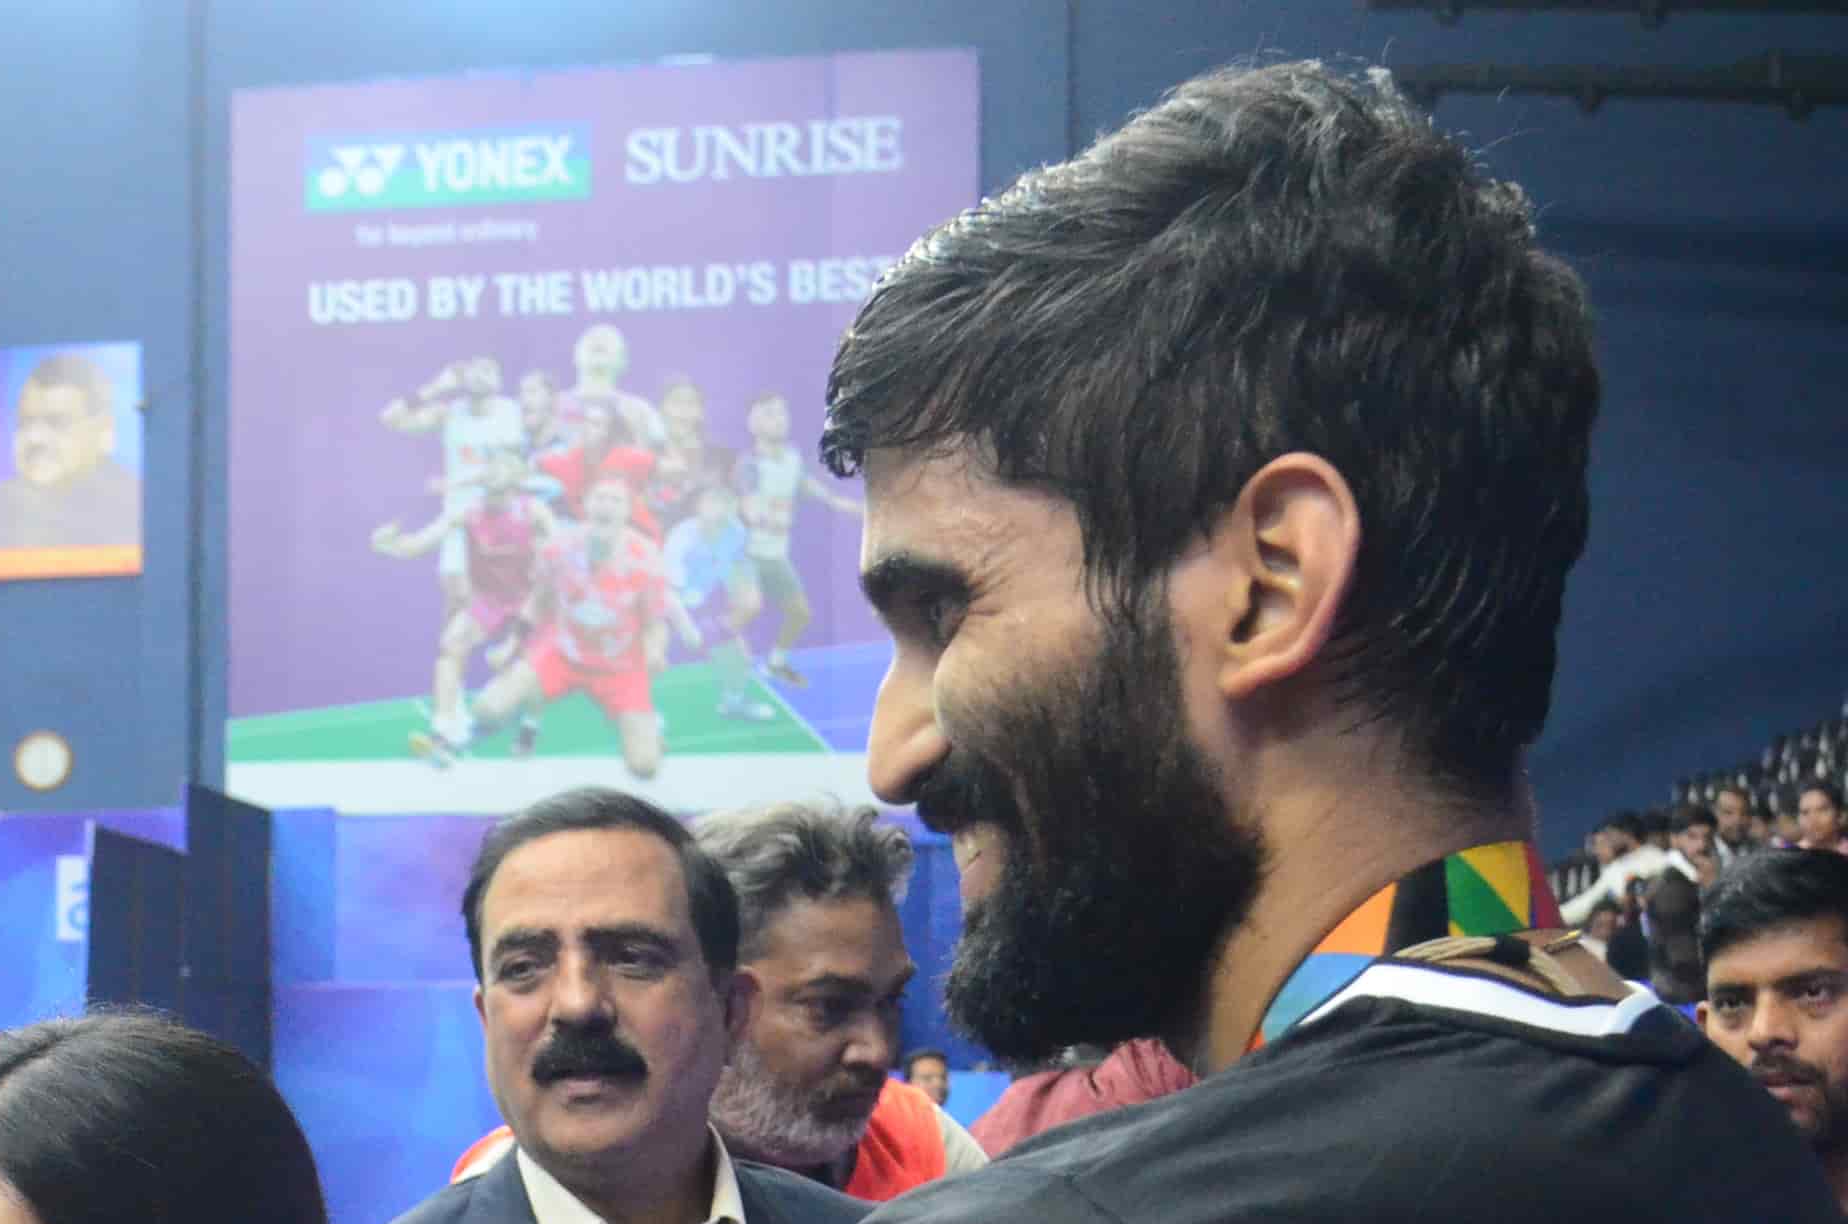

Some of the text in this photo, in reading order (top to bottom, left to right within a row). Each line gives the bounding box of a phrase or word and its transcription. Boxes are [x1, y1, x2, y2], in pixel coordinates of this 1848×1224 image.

[416, 134, 573, 192] YONEX
[624, 116, 902, 184] SUNRISE
[309, 277, 418, 324] USED
[427, 273, 488, 319] BY
[493, 269, 574, 314] THE
[577, 260, 776, 312] WORLD'S
